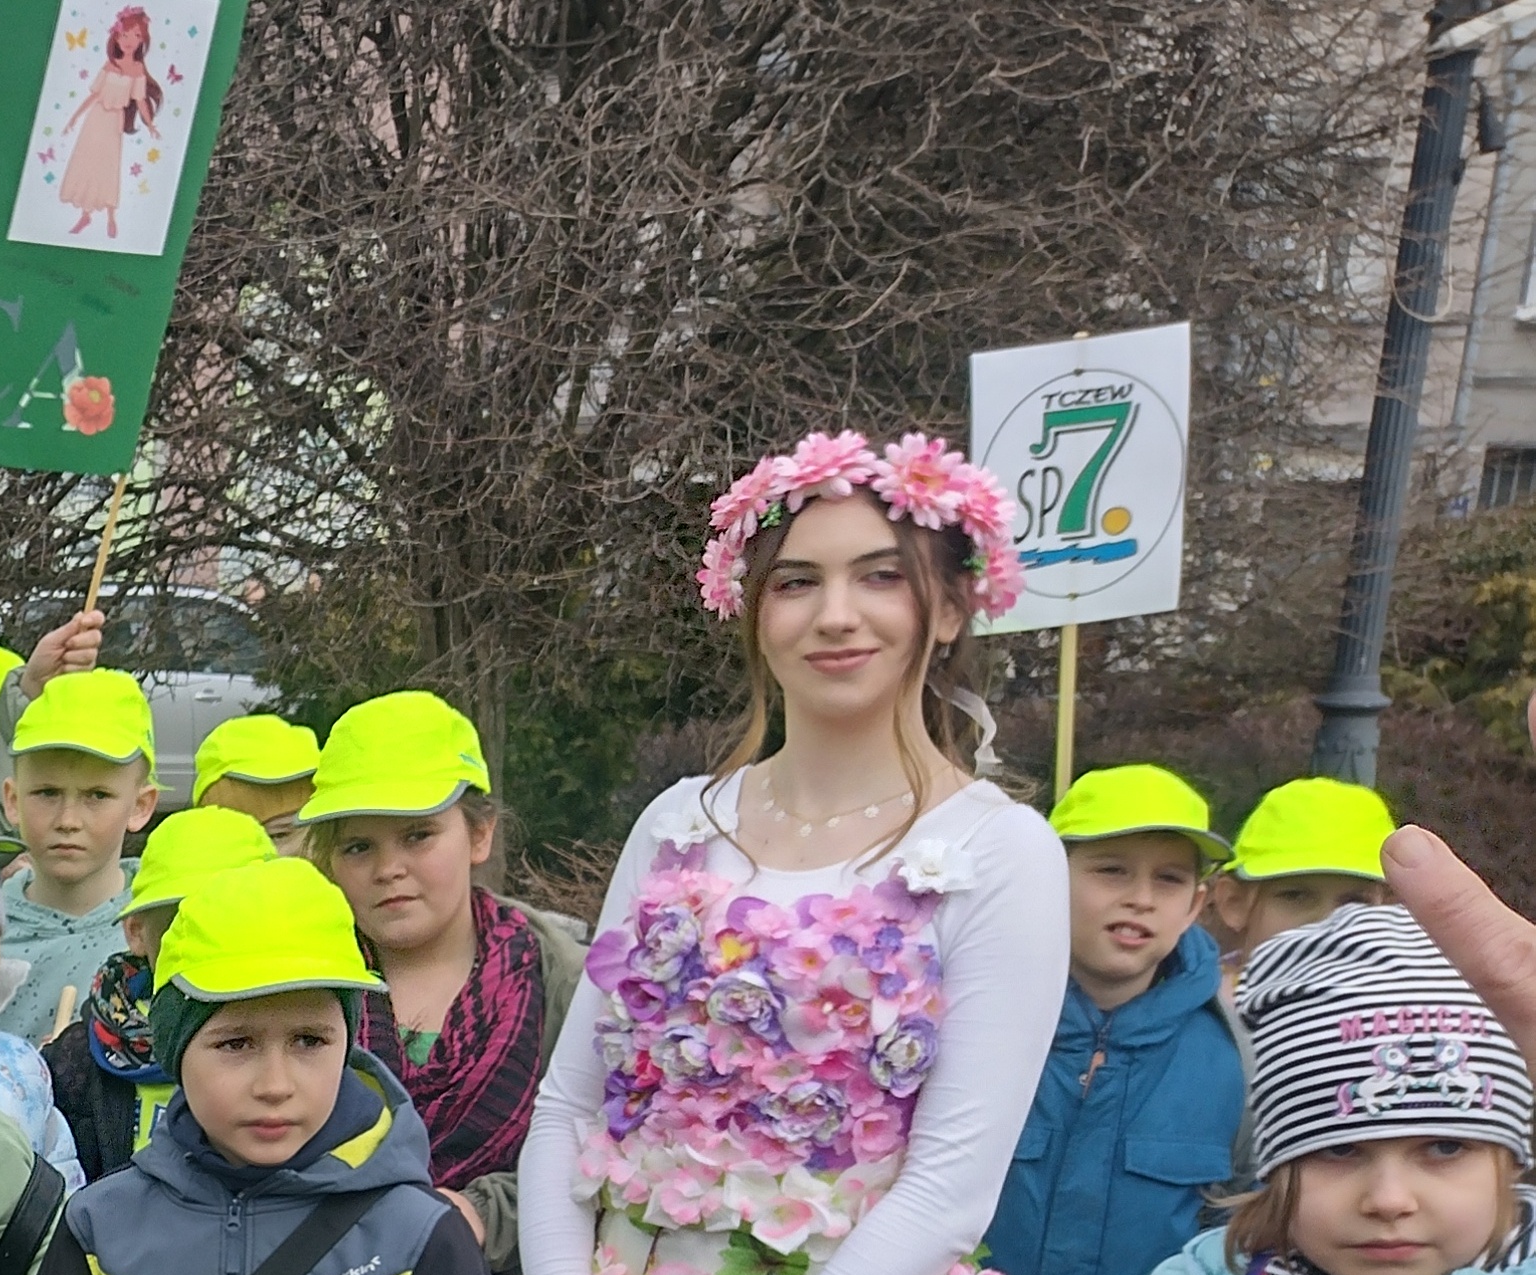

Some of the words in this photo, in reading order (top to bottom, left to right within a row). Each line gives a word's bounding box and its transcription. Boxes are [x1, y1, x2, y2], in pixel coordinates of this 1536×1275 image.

[1041, 383, 1135, 409] TCZEW
[1013, 466, 1064, 544] SP
[1339, 1006, 1492, 1044] MAGICAL
